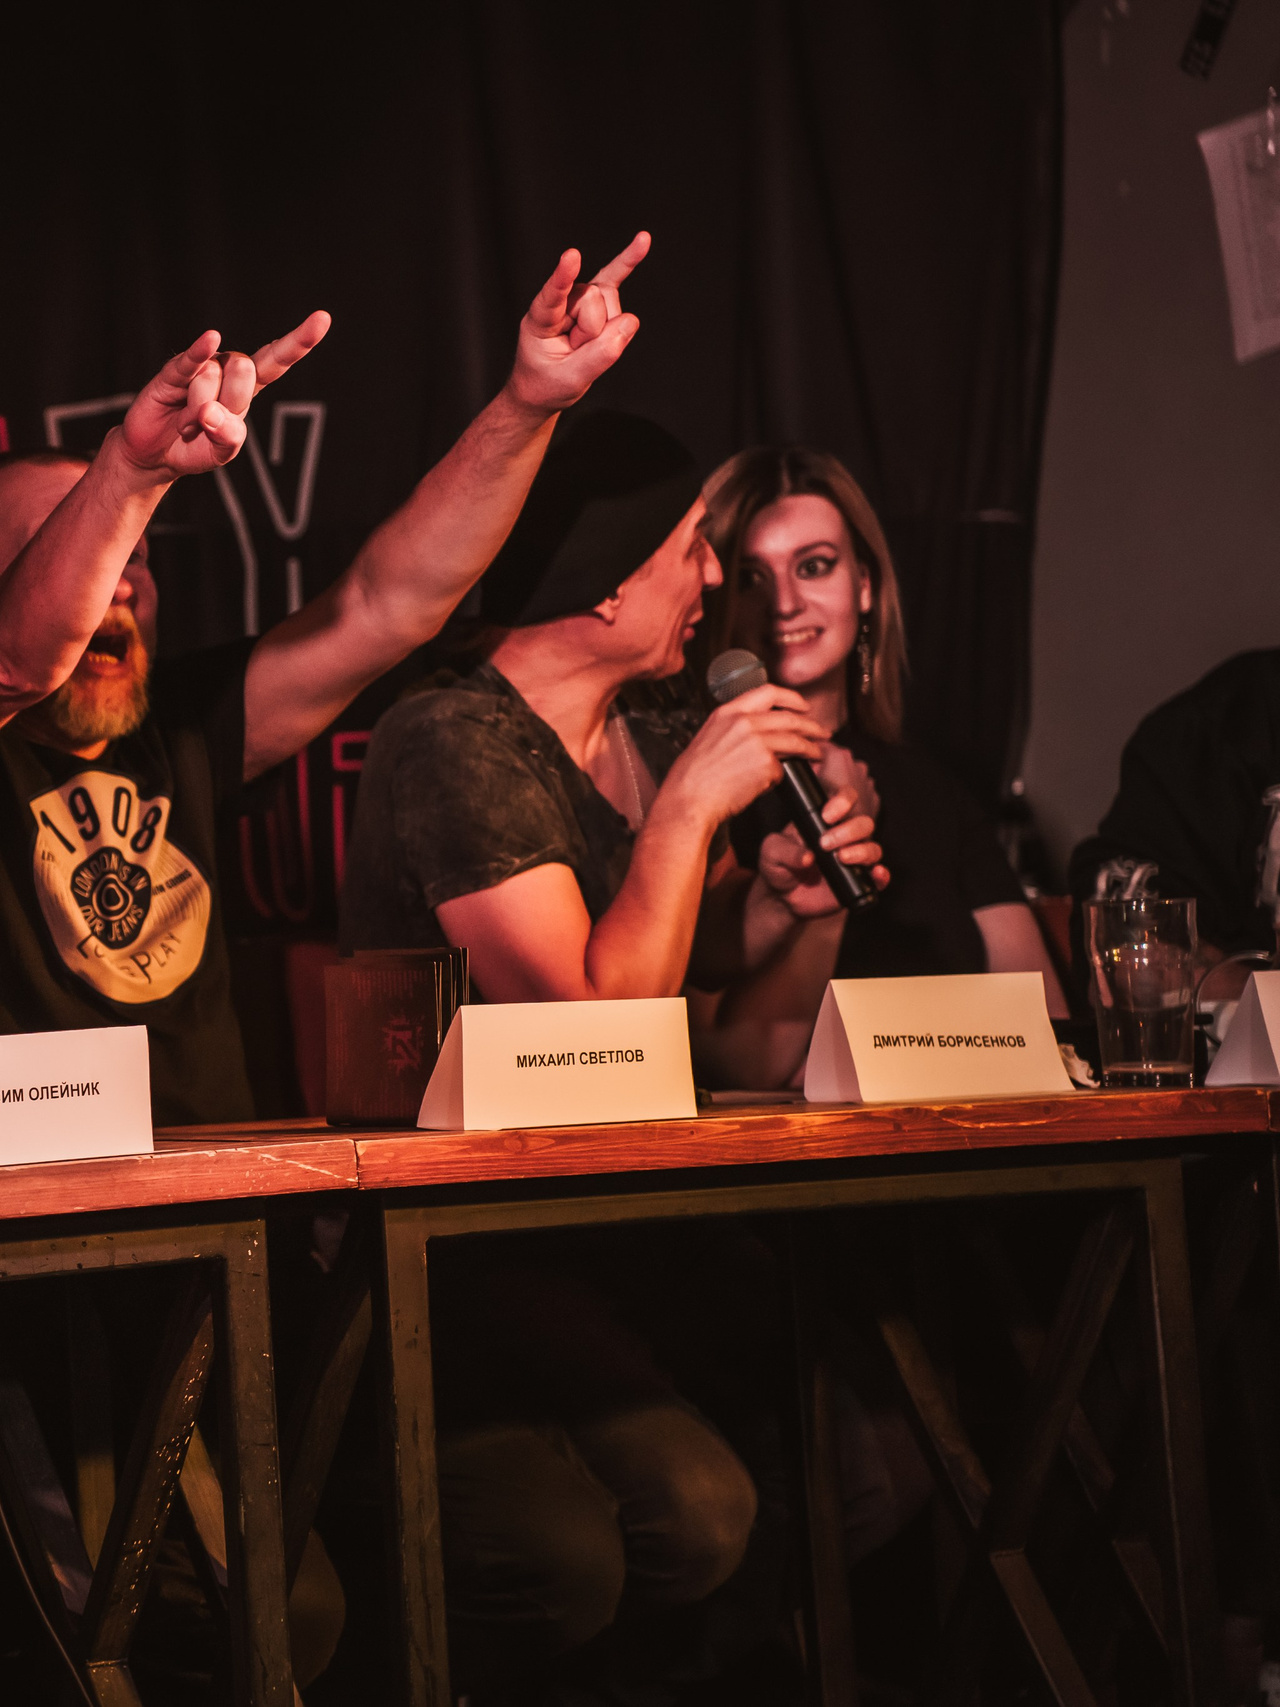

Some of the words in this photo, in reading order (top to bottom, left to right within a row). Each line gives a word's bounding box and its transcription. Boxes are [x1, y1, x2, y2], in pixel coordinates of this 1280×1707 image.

[39, 785, 163, 854] 1908
[873, 1033, 935, 1049] ДМИТРИЙ
[937, 1035, 1026, 1048] БОРИСЕНКОВ
[516, 1053, 575, 1068] МИХАИЛ
[579, 1049, 645, 1065] СВЕТЛОВ
[28, 1081, 100, 1101] ОЛЕЙНИК
